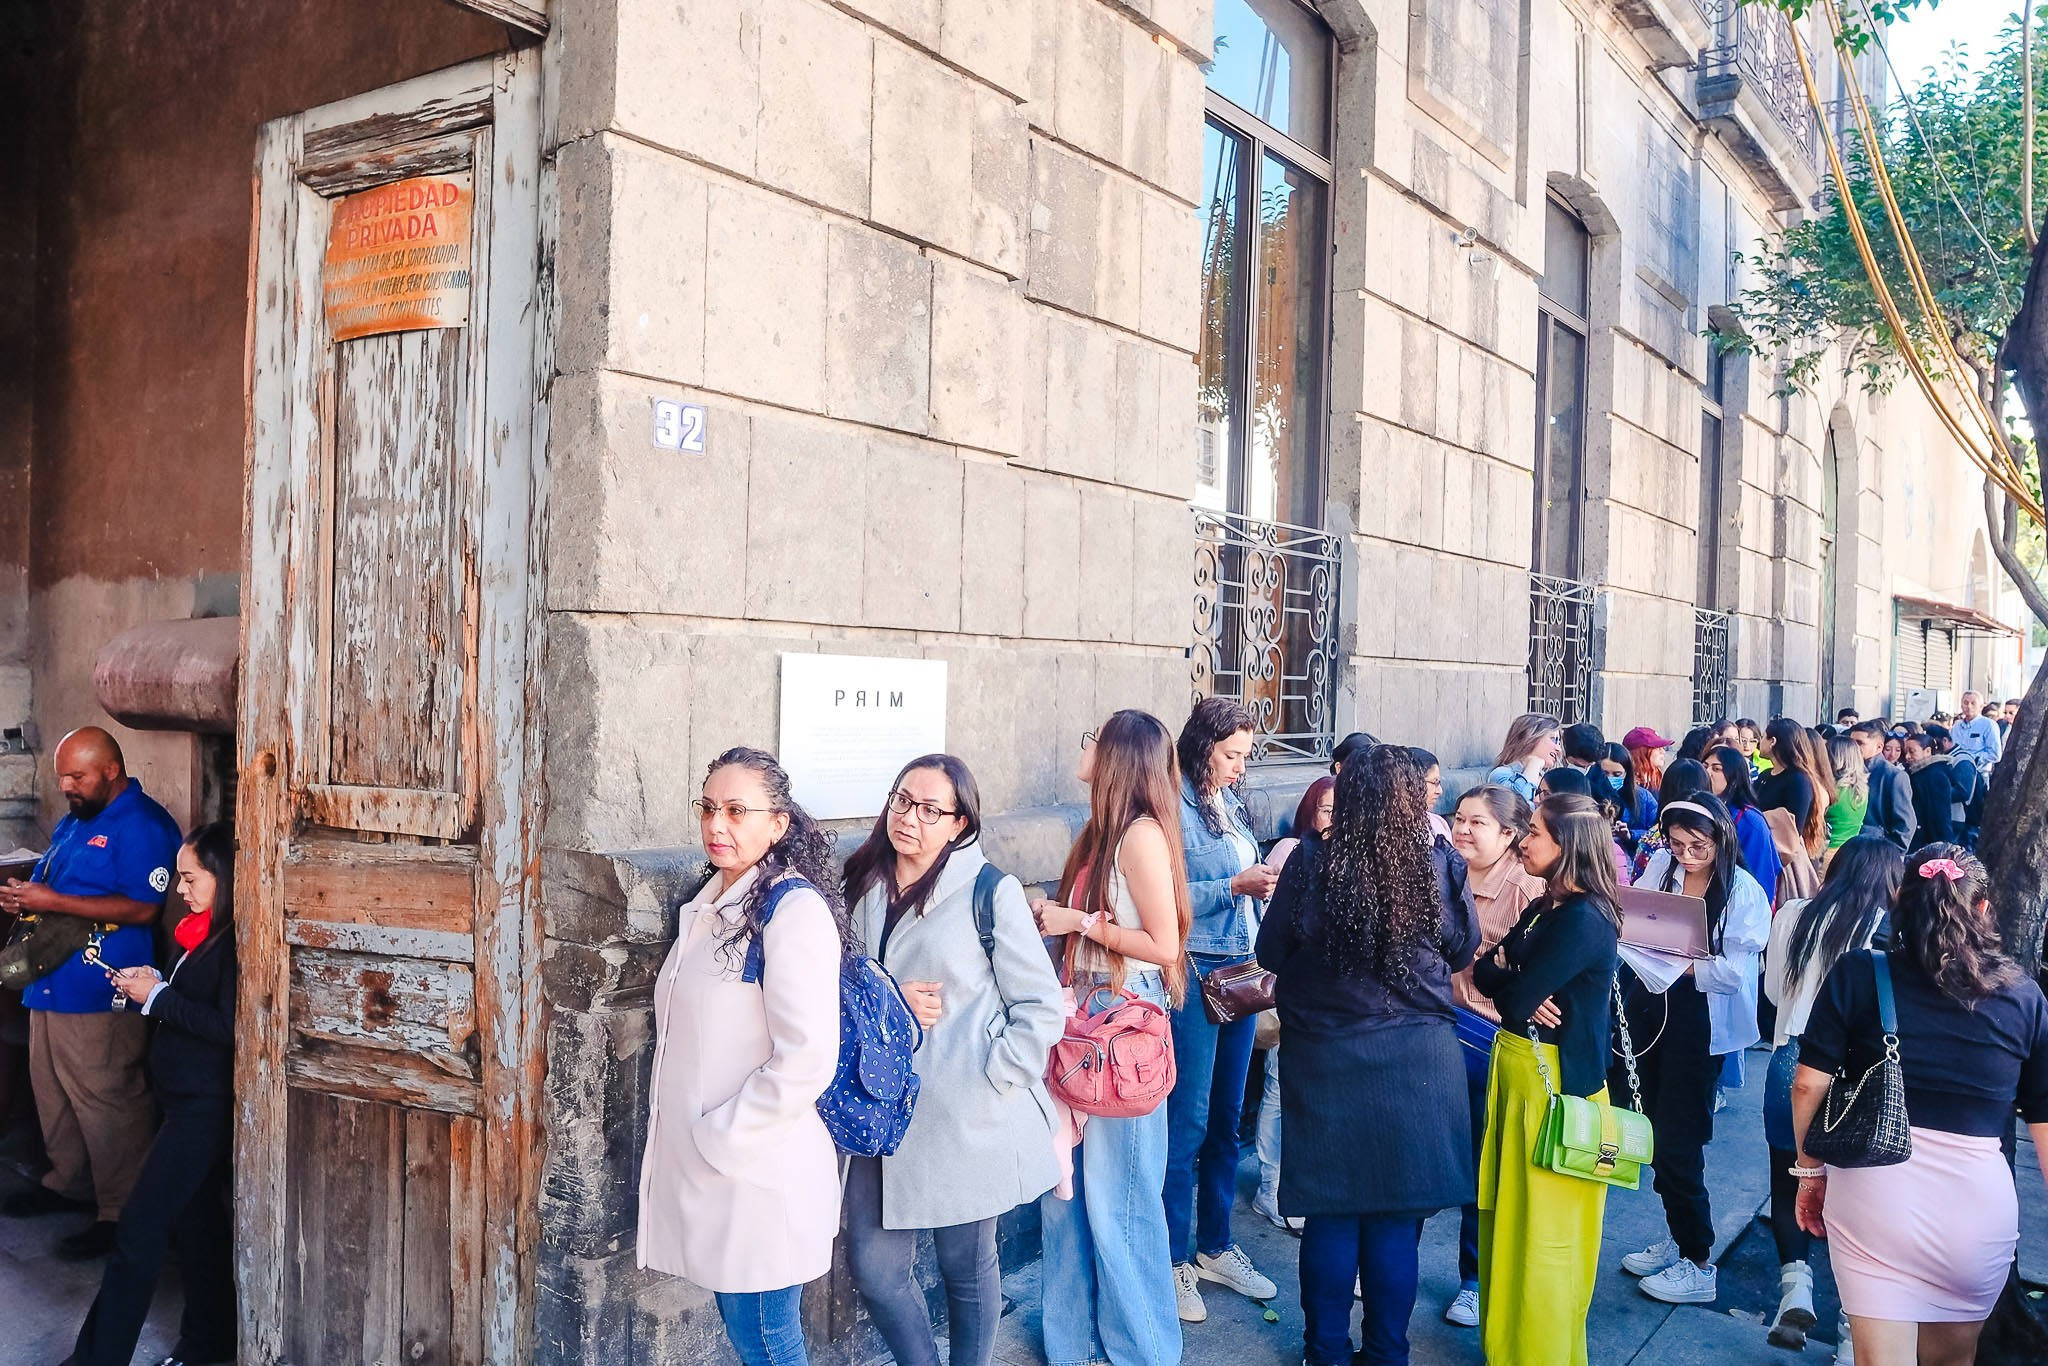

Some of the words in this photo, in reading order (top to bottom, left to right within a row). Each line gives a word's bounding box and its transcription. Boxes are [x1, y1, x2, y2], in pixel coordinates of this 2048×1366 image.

[347, 213, 437, 249] PRIVADA
[656, 400, 703, 452] 32
[835, 689, 903, 708] PRIM
